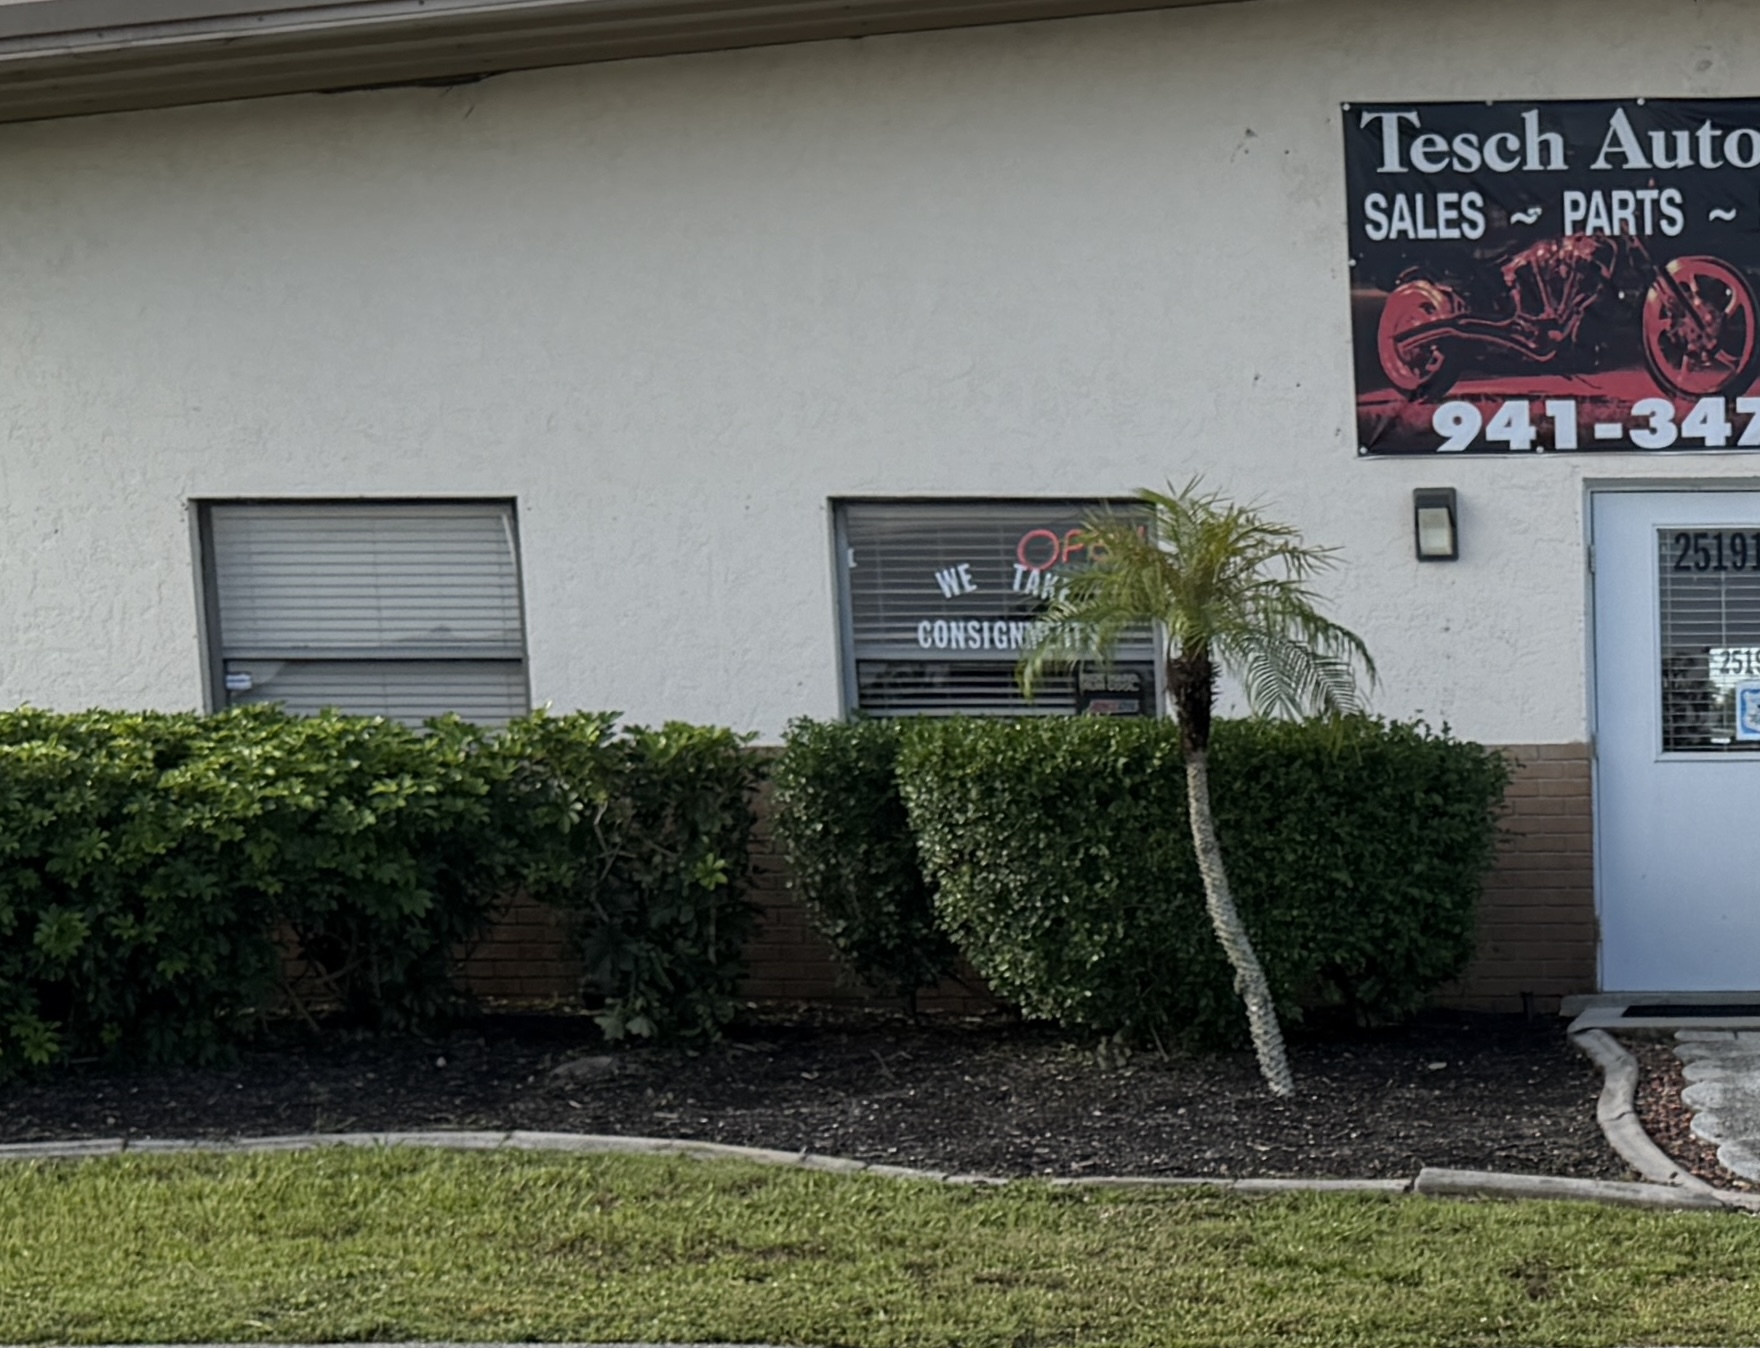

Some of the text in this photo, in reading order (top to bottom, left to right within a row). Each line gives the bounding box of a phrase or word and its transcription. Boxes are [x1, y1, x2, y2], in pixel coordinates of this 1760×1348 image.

[1360, 109, 1569, 173] Tesch
[1363, 191, 1486, 241] SALES
[1562, 188, 1685, 238] PARTS
[934, 562, 978, 599] WE
